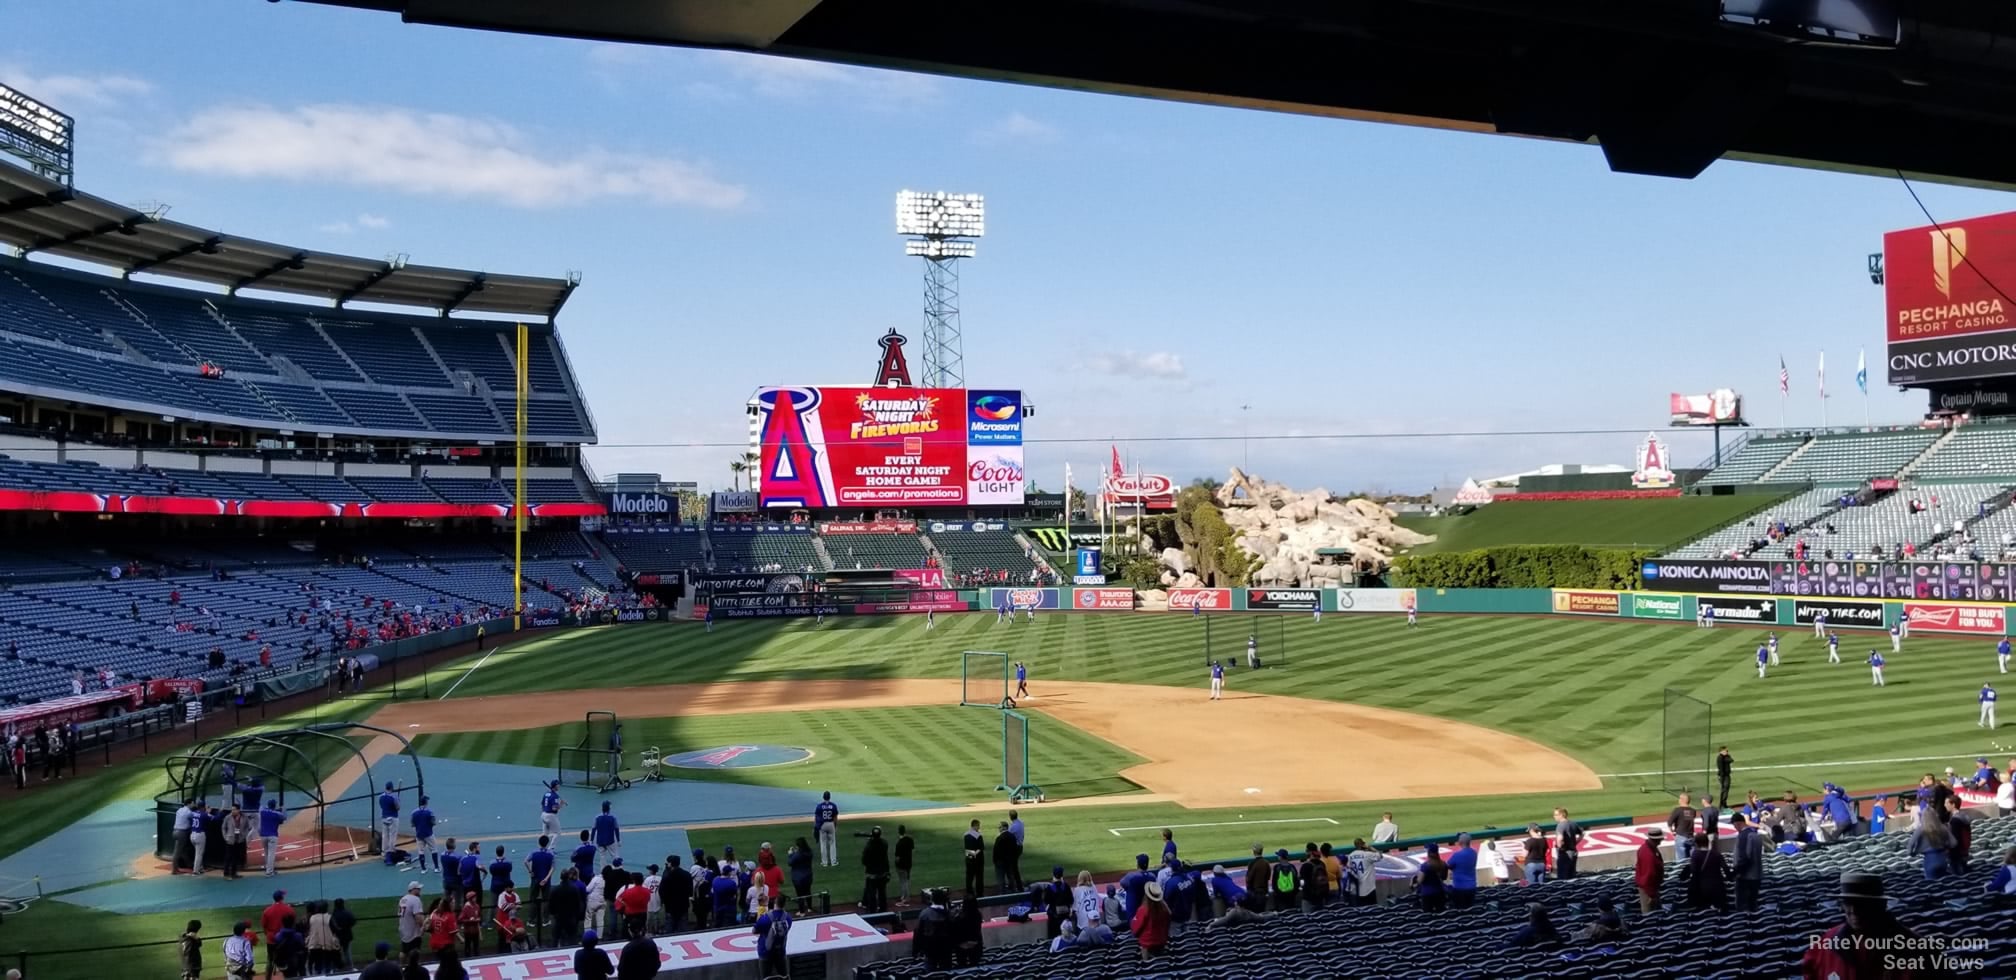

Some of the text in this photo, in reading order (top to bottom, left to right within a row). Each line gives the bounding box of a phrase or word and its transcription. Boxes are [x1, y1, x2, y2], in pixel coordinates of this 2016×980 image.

[1899, 299, 2004, 324] PECHANGA
[1900, 314, 2005, 335] RESORT CASINO
[1890, 352, 1932, 371] CNC
[1940, 390, 2008, 408] Captain Morgan
[861, 399, 928, 412] SATURDAY
[874, 411, 915, 423] NIGHT
[850, 419, 940, 440] FIREWORKS
[971, 421, 1020, 432] Microsemi
[884, 455, 922, 465] EVERY
[855, 466, 951, 476] SATURDAY NIGHT
[968, 460, 1023, 482] Coors
[866, 476, 941, 486] HOME GAME!
[978, 482, 1015, 493] LIGHT
[843, 489, 960, 500] angels.com/promotions
[612, 492, 668, 513] Modelo
[720, 494, 753, 507] Modelo
[1659, 565, 1769, 580] KONICA MINOLTA
[1785, 563, 1792, 573] 3
[1813, 563, 1820, 573] 6
[1841, 564, 1847, 574] 1
[1870, 564, 1877, 574] 7
[1901, 566, 1907, 575] 1
[1931, 565, 1940, 575] 4
[922, 572, 941, 586] LA
[1784, 581, 1794, 592] 10
[1814, 583, 1820, 592] 1
[1840, 584, 1851, 594] 11
[1871, 585, 1878, 595] 4
[1899, 586, 1912, 596] 16
[1932, 586, 1940, 596] 6
[1266, 591, 1317, 601] YOKOHAMA
[1965, 587, 1973, 598] 3
[1999, 588, 2005, 599] 1
[1571, 595, 1618, 605] PECHANGA
[1646, 599, 1680, 609] National
[756, 608, 783, 616] StubHub
[1699, 602, 1761, 618] Termador
[1831, 606, 1882, 621] TIRE.COM
[1958, 607, 2003, 618] THIS BUD'S
[533, 617, 559, 626] Fanatics
[1958, 617, 1996, 628] FOR YOU.
[822, 810, 833, 820] 82
[1083, 898, 1097, 912] 27
[811, 920, 876, 943] A
